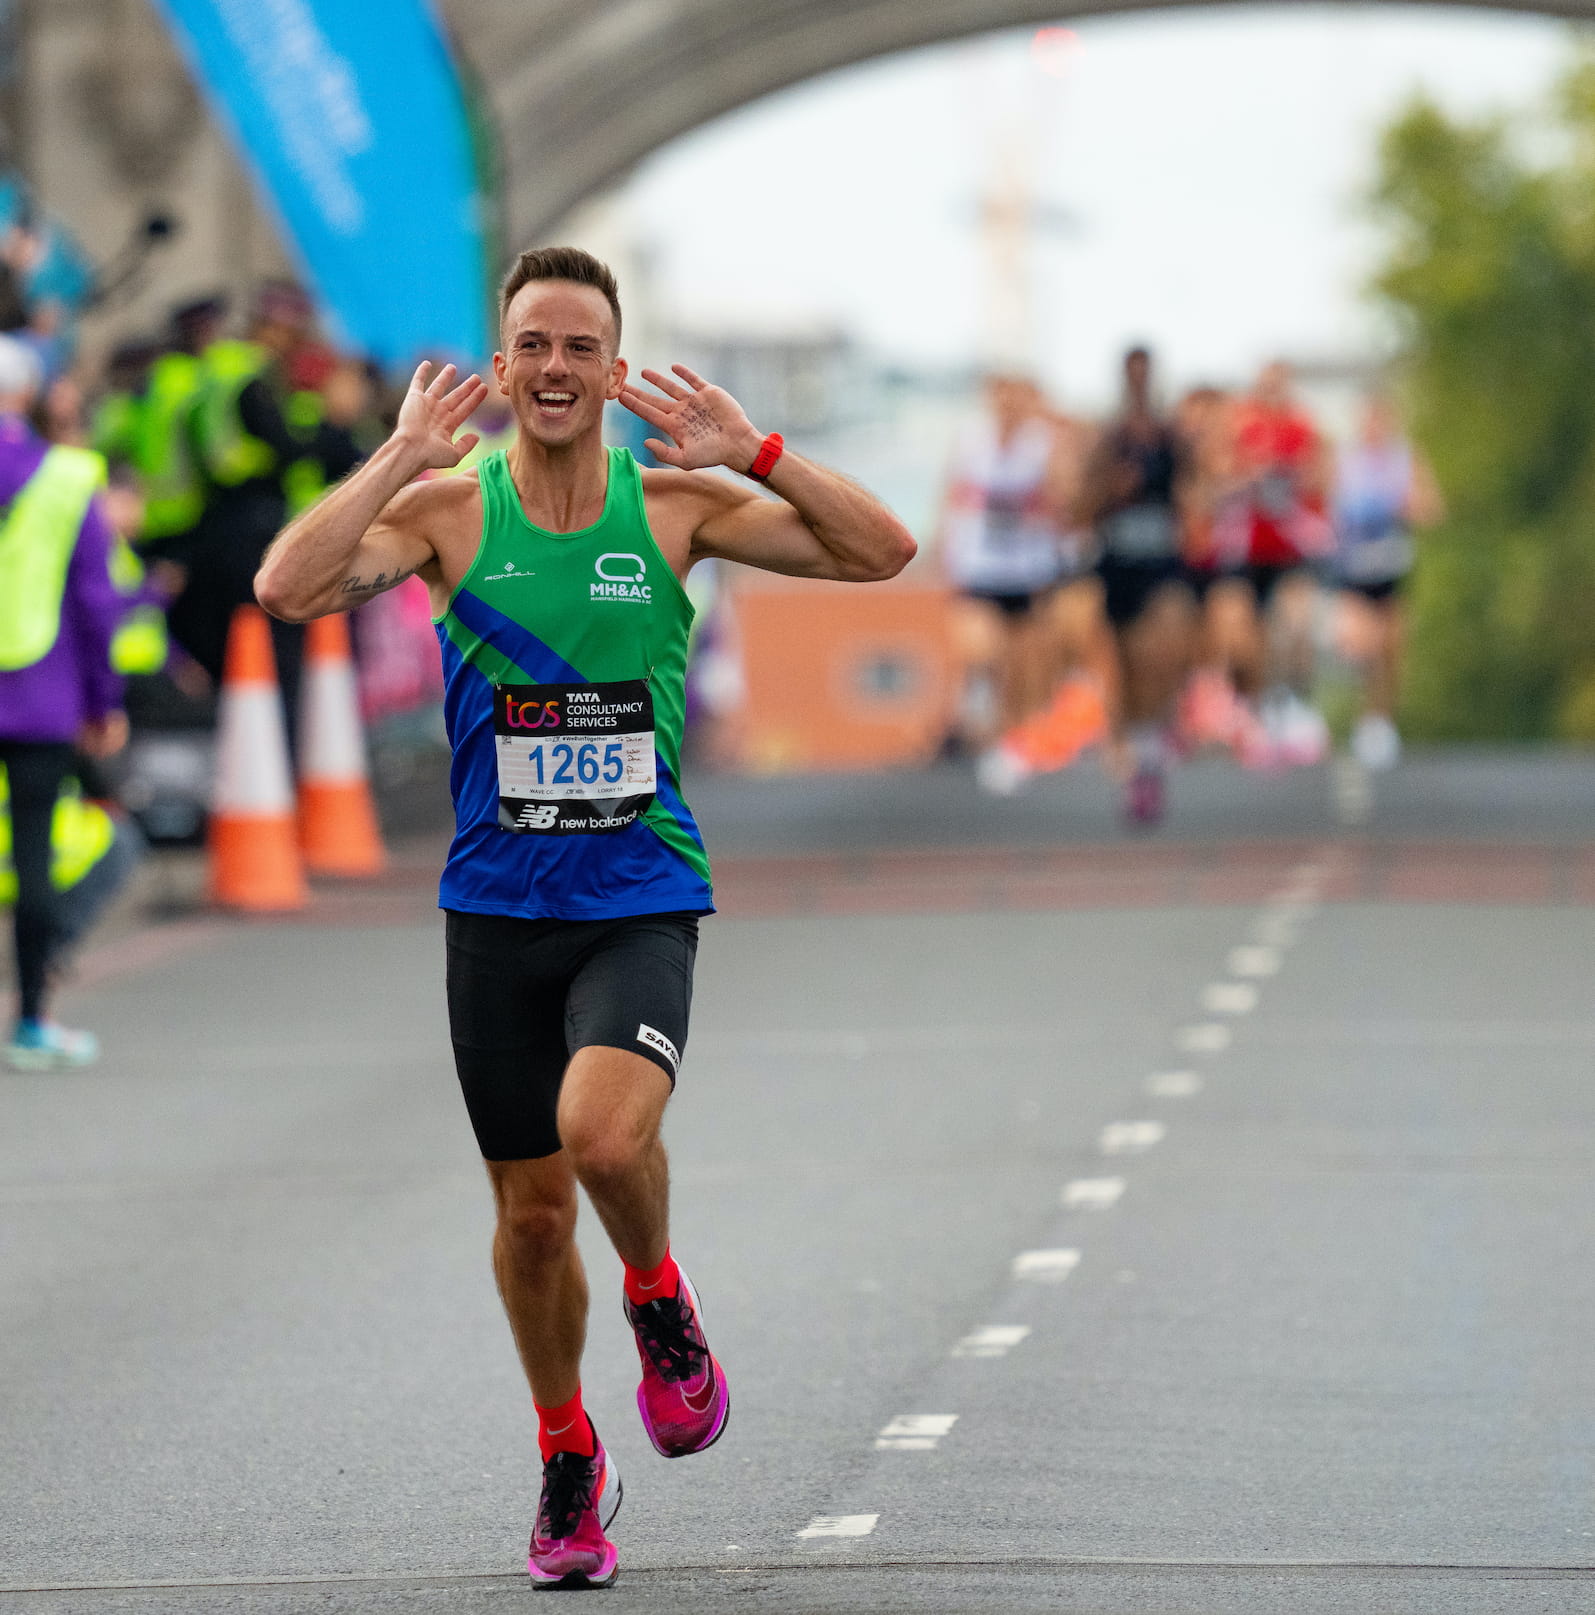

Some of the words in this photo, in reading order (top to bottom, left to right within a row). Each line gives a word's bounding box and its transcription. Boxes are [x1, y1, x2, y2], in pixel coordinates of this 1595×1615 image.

[590, 583, 652, 599] MH&AC
[566, 693, 600, 703] TATA
[506, 694, 561, 728] tcs
[566, 701, 643, 716] CONSULTANCY
[566, 716, 617, 728] SERVICES
[529, 743, 623, 785] 1265
[560, 818, 587, 829] new
